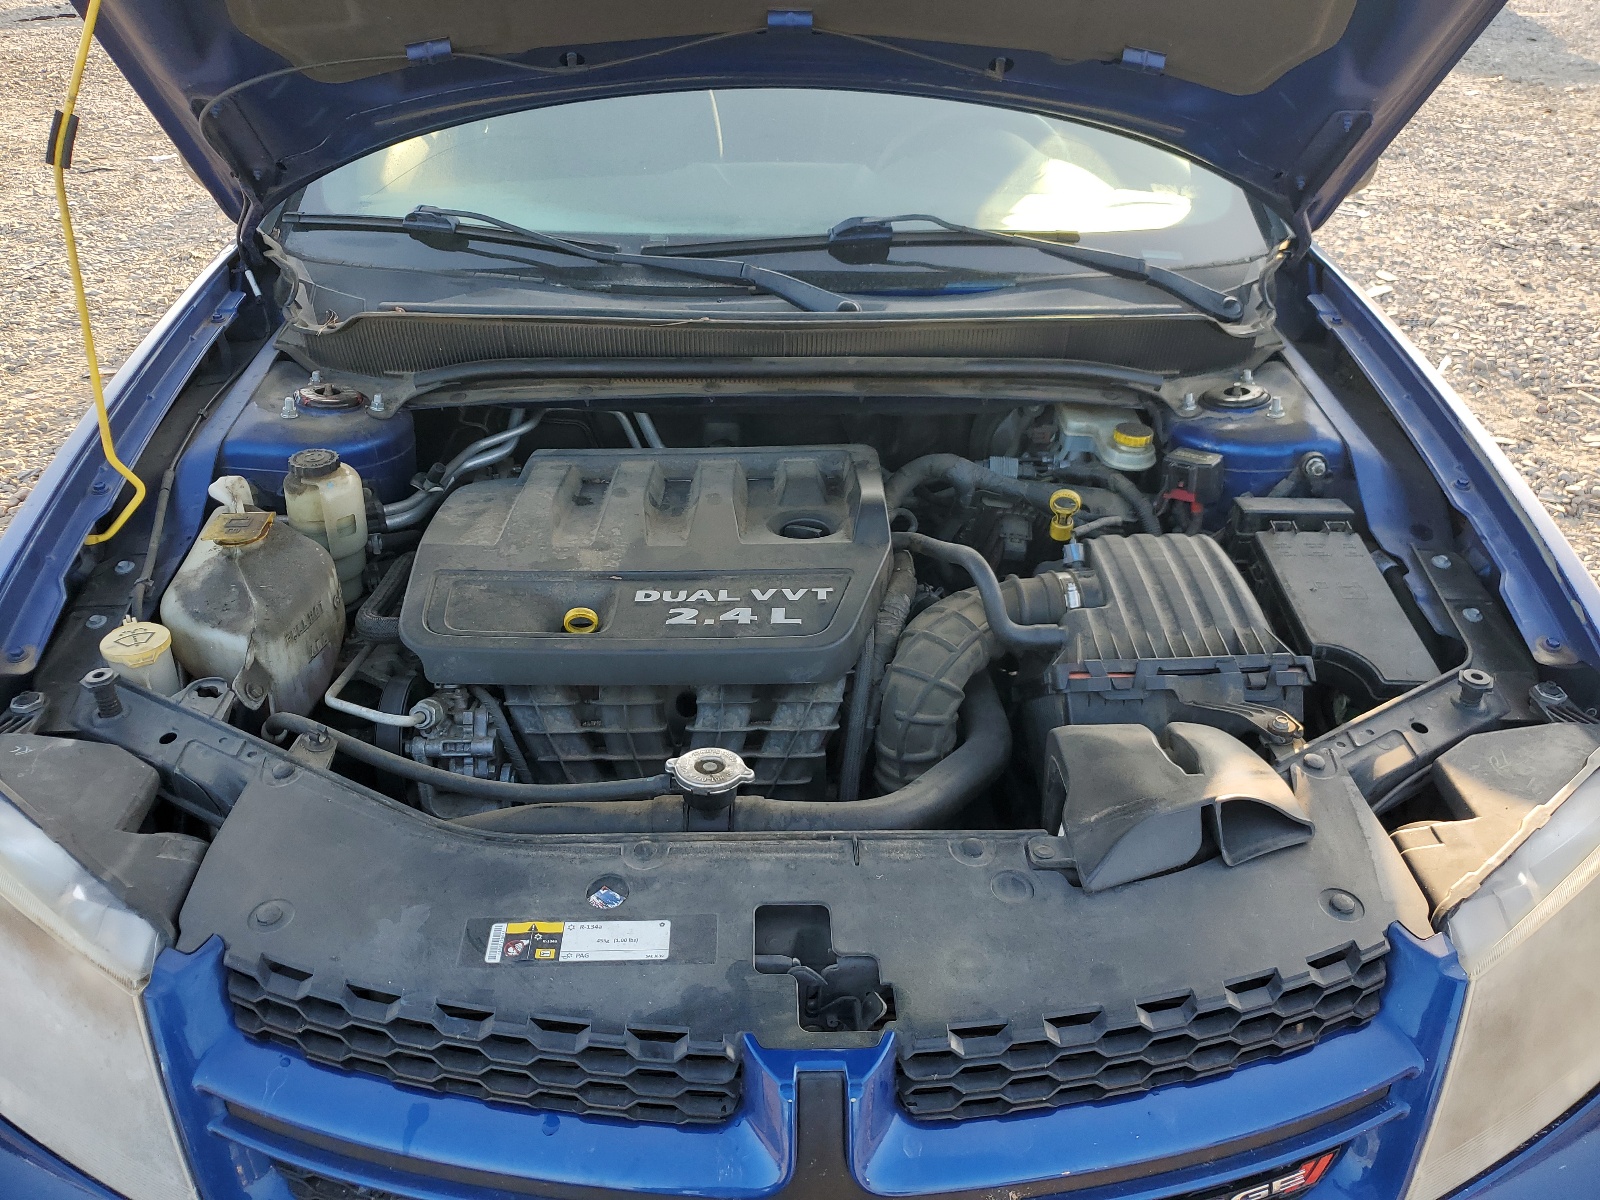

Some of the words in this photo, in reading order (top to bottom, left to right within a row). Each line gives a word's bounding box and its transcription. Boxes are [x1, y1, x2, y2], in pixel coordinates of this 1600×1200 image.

[634, 589, 741, 602] DUAL
[750, 587, 834, 600] VVT
[665, 607, 758, 625] 2.4
[770, 607, 802, 624] L
